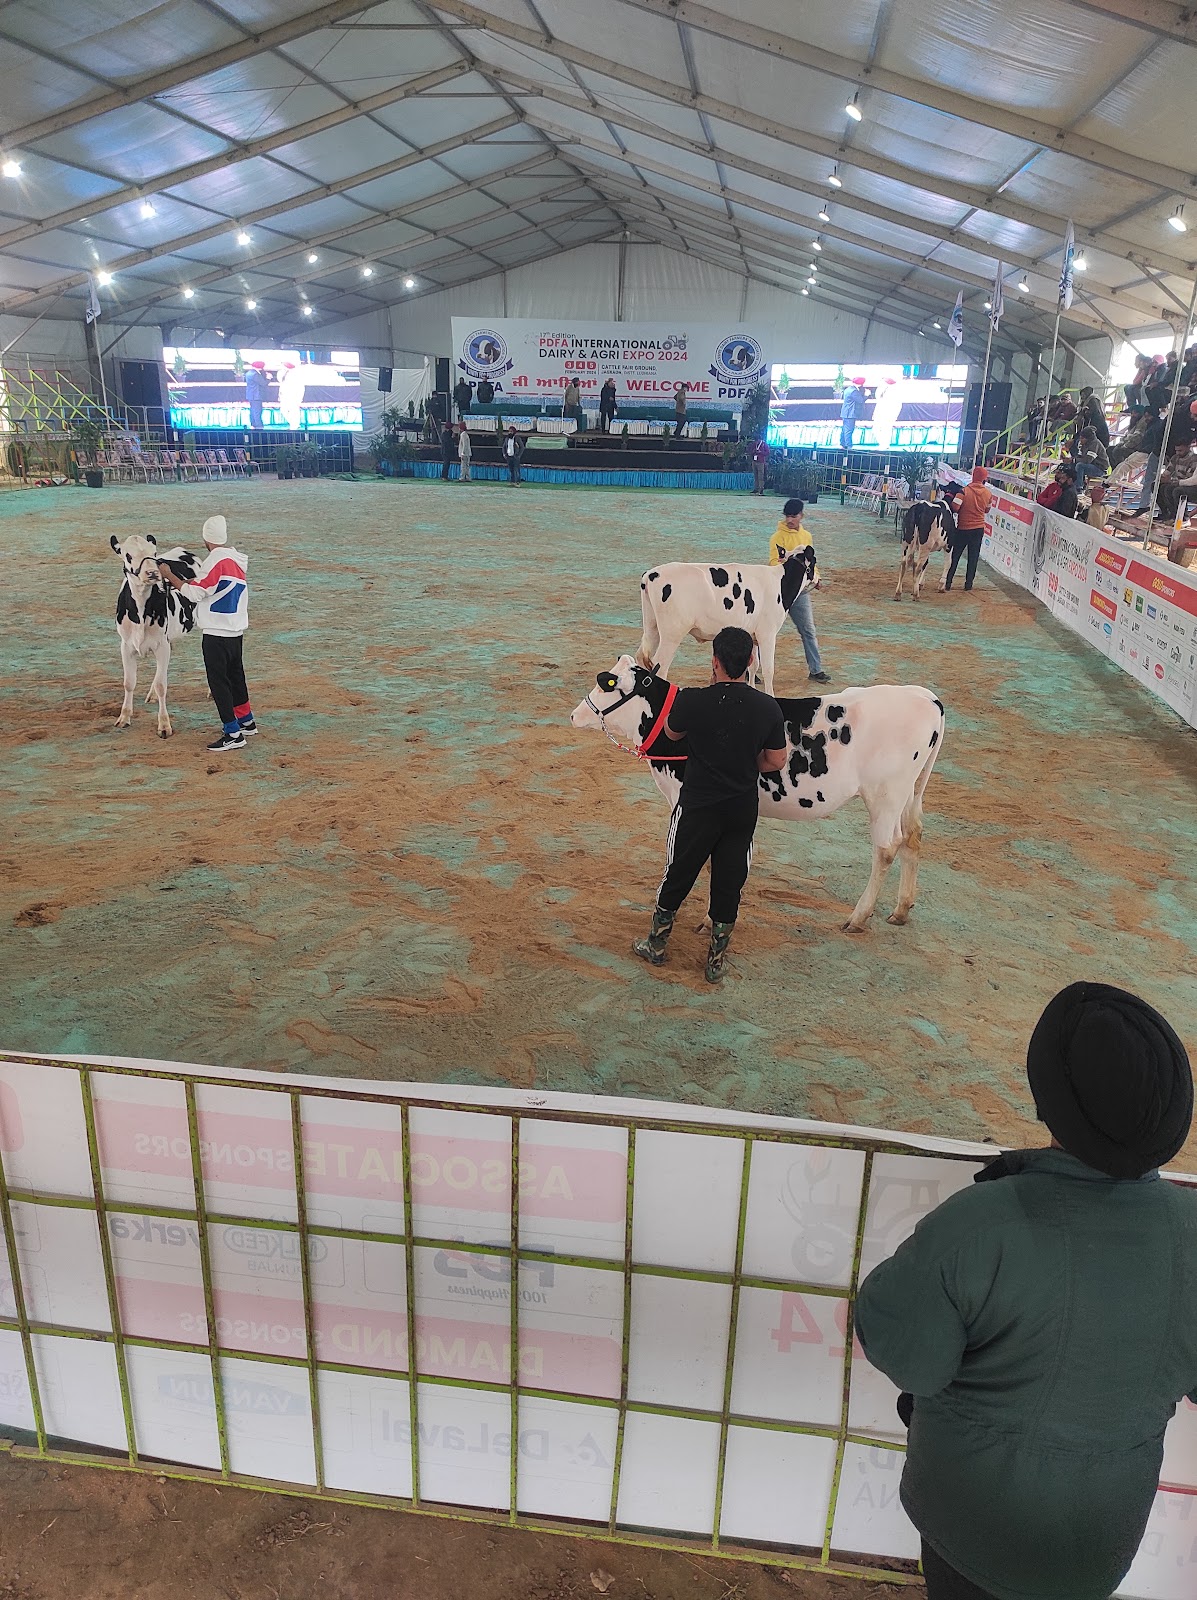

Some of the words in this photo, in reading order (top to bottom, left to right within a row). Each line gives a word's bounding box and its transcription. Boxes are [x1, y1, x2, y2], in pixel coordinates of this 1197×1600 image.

[539, 338, 569, 348] PDFA
[571, 339, 661, 350] INTERNATIONAL
[539, 348, 575, 359] DAIRY
[578, 349, 587, 359] &
[590, 350, 619, 360] AGRI
[622, 351, 655, 361] EXPO
[657, 351, 688, 361] 2024
[626, 379, 710, 393] WELCOME
[718, 387, 754, 399] PDFA
